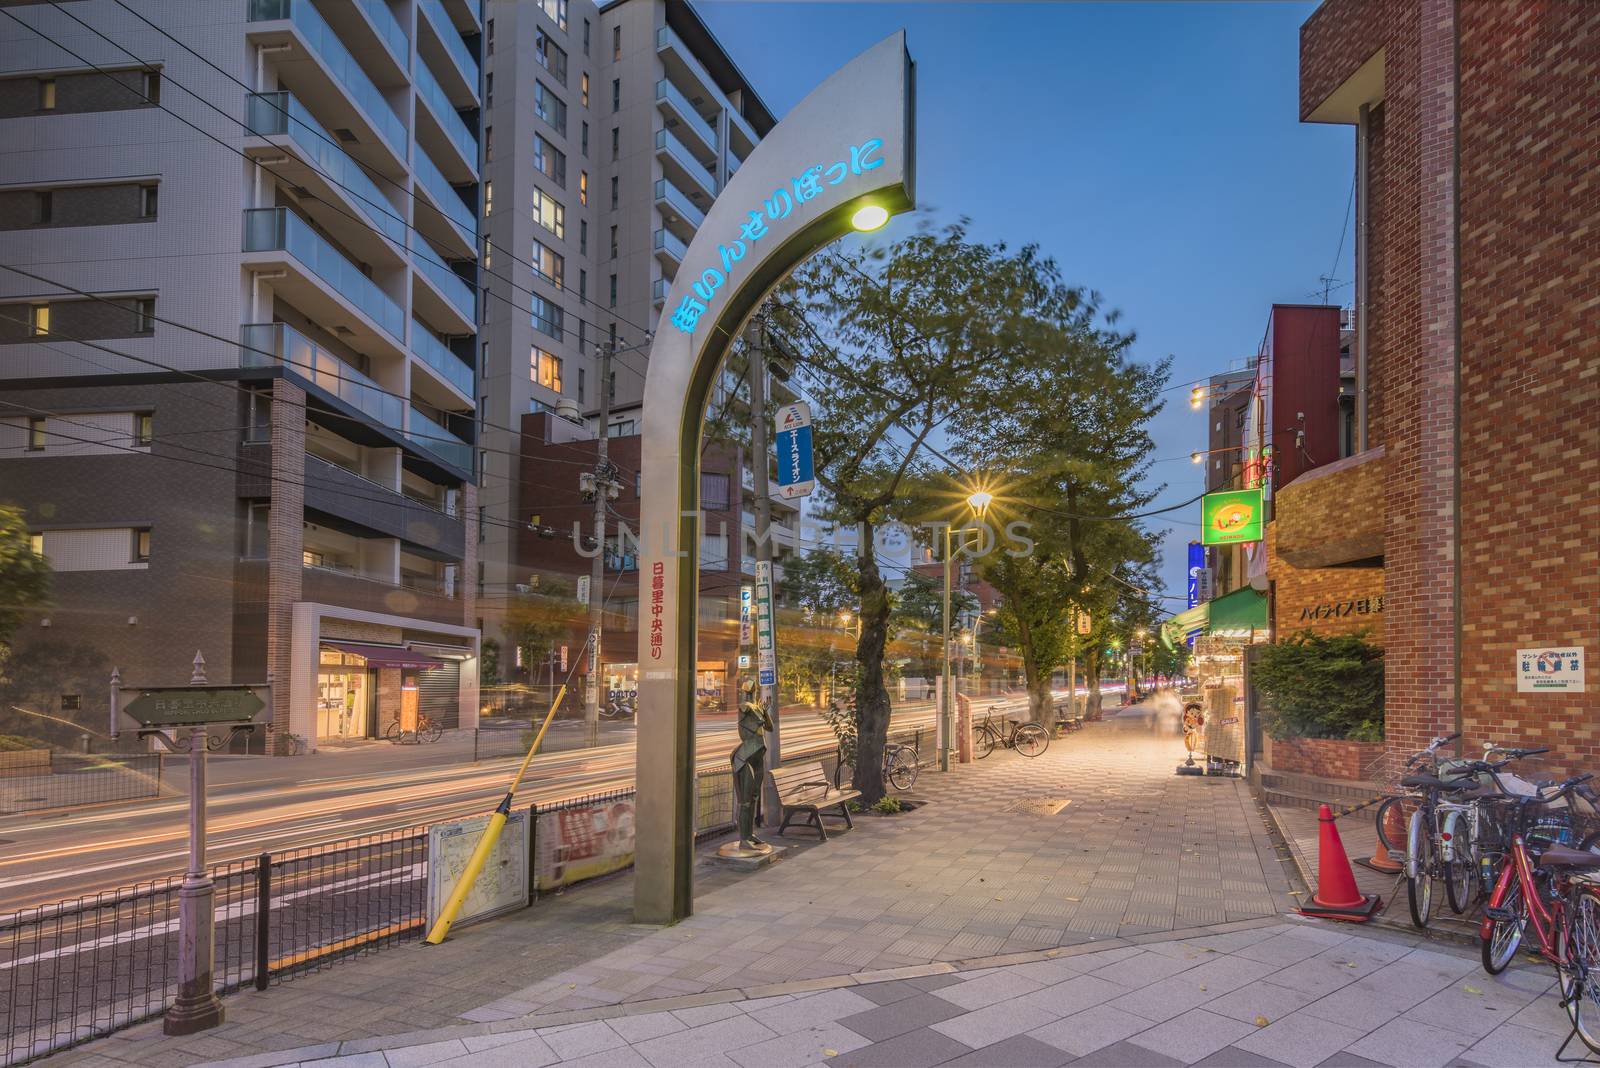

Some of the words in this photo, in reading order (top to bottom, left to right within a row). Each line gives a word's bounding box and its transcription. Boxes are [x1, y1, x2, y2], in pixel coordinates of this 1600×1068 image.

[790, 430, 801, 483] エースライオン
[651, 562, 665, 660] 日暮里中央通り
